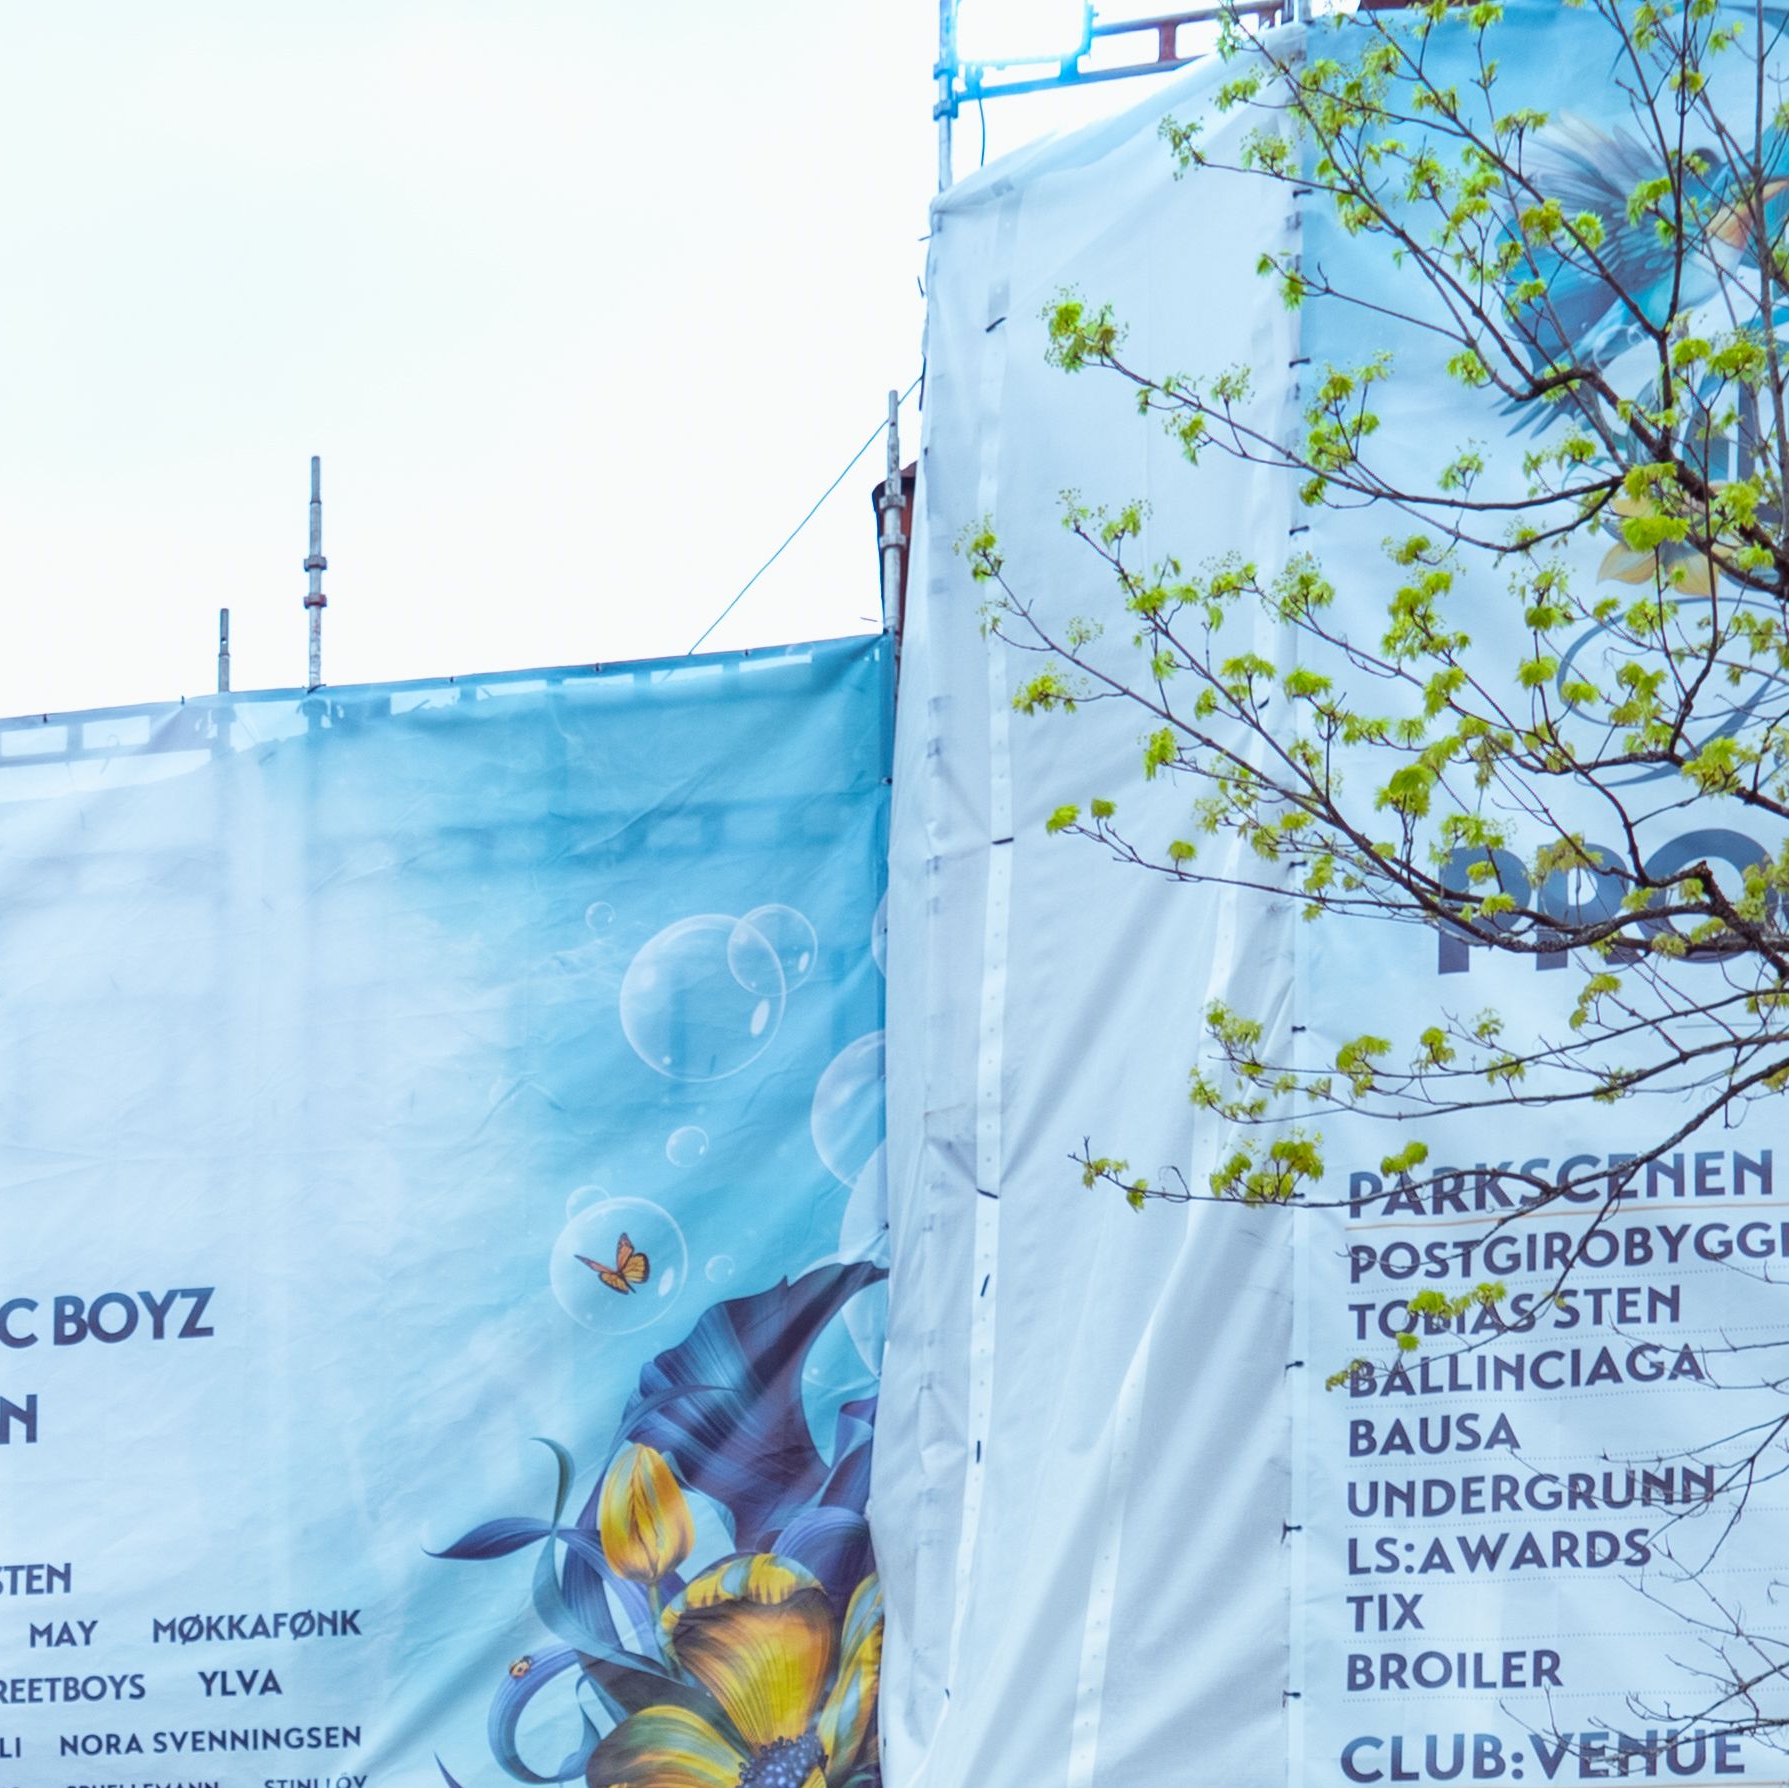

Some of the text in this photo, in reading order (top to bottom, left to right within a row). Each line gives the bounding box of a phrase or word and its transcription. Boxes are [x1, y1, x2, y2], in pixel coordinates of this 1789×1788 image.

[1438, 828, 1789, 975] PRO
[1349, 1149, 1773, 1219] PARKSCENEN
[53, 1286, 216, 1346] BOYZ
[1349, 1285, 1681, 1341] TOBIAS STEN
[1349, 1343, 1705, 1398] BALLINCIAGA
[1349, 1412, 1522, 1458] BAUSA
[1347, 1464, 1716, 1519] UNDERGRUNN
[1348, 1528, 1653, 1576] LS:AWARDS
[30, 1620, 98, 1648] MAY
[152, 1608, 362, 1645] MØKKAFØNK
[1346, 1592, 1426, 1633] TIX
[197, 1668, 283, 1698] YLVA
[1347, 1649, 1564, 1692] BROILER
[60, 1733, 144, 1757] NORA
[152, 1725, 362, 1754] SVENNINGSEN
[1341, 1727, 1745, 1784] CLUB:VENUE
